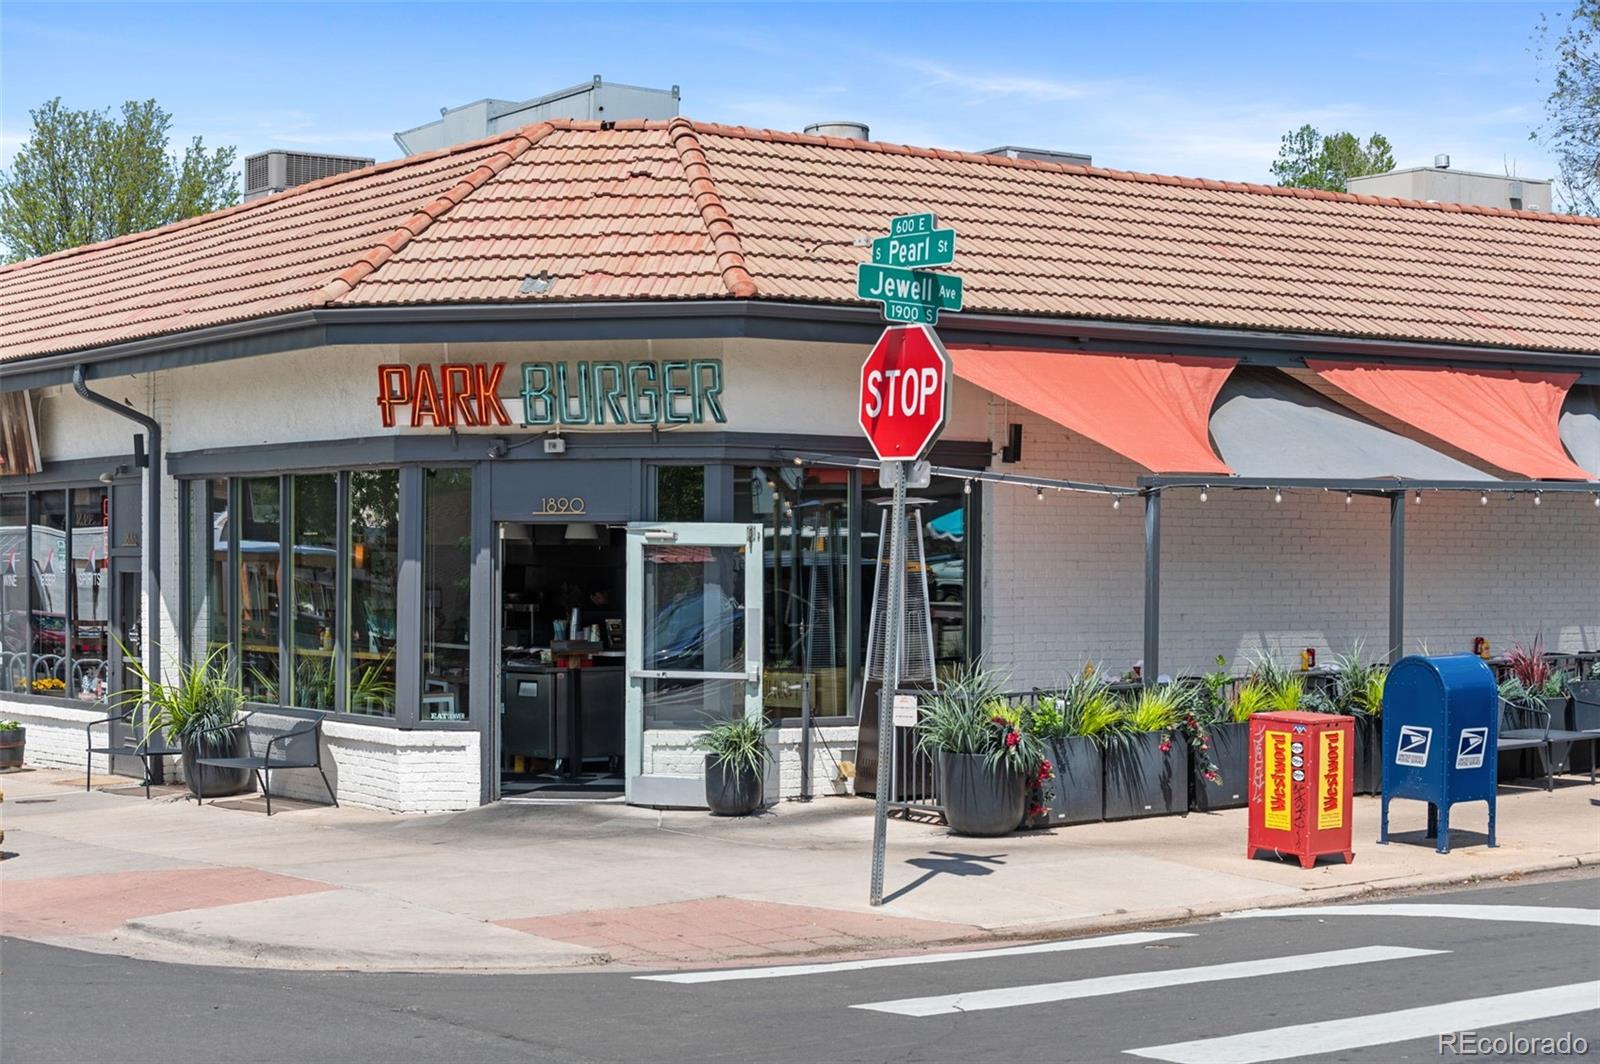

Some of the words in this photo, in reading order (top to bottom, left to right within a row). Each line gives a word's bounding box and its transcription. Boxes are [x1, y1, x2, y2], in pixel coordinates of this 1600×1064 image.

[895, 218, 915, 233] 600
[918, 217, 926, 231] E
[875, 247, 882, 260] S
[888, 236, 930, 264] Pearl
[937, 239, 948, 253] St
[869, 271, 932, 302] Jewell
[938, 285, 957, 300] Ave
[891, 304, 919, 320] 1900
[925, 309, 933, 322] S
[377, 362, 513, 428] PARK
[521, 359, 728, 426] BURGER
[865, 367, 938, 418] STOP
[542, 497, 585, 513] 1890
[1270, 733, 1286, 812] Westword
[1323, 732, 1339, 812] Westword
